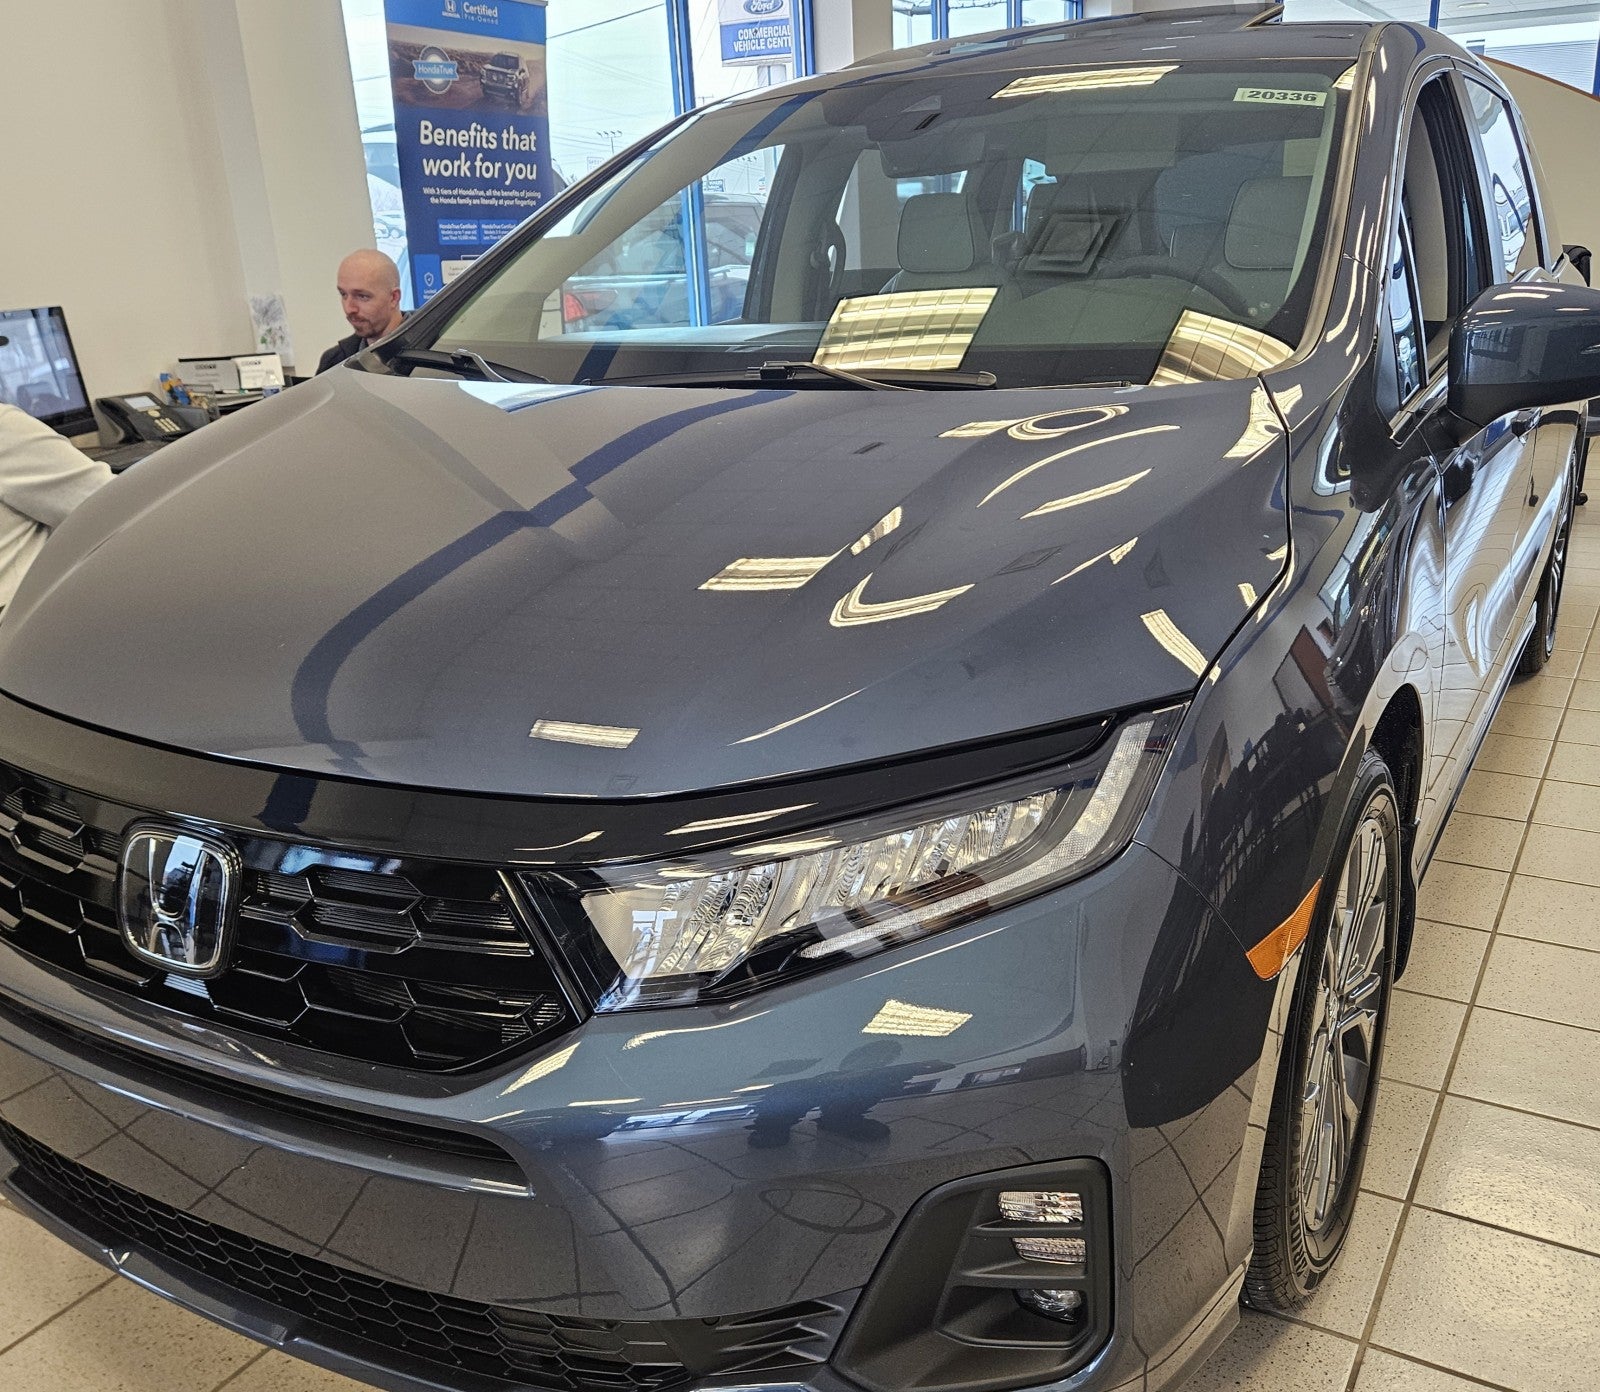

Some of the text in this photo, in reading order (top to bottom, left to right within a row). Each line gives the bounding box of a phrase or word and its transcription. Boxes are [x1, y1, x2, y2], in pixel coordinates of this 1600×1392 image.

[463, 2, 498, 17] Certified
[738, 25, 791, 40] COMMERCIAL
[733, 39, 766, 52] VEHICLE
[418, 64, 454, 75] HondaTrue
[1247, 90, 1317, 102] 20336
[420, 119, 537, 152] Benefits that
[422, 152, 537, 186] work for you
[1290, 1095, 1307, 1277] BRIDGESTO
